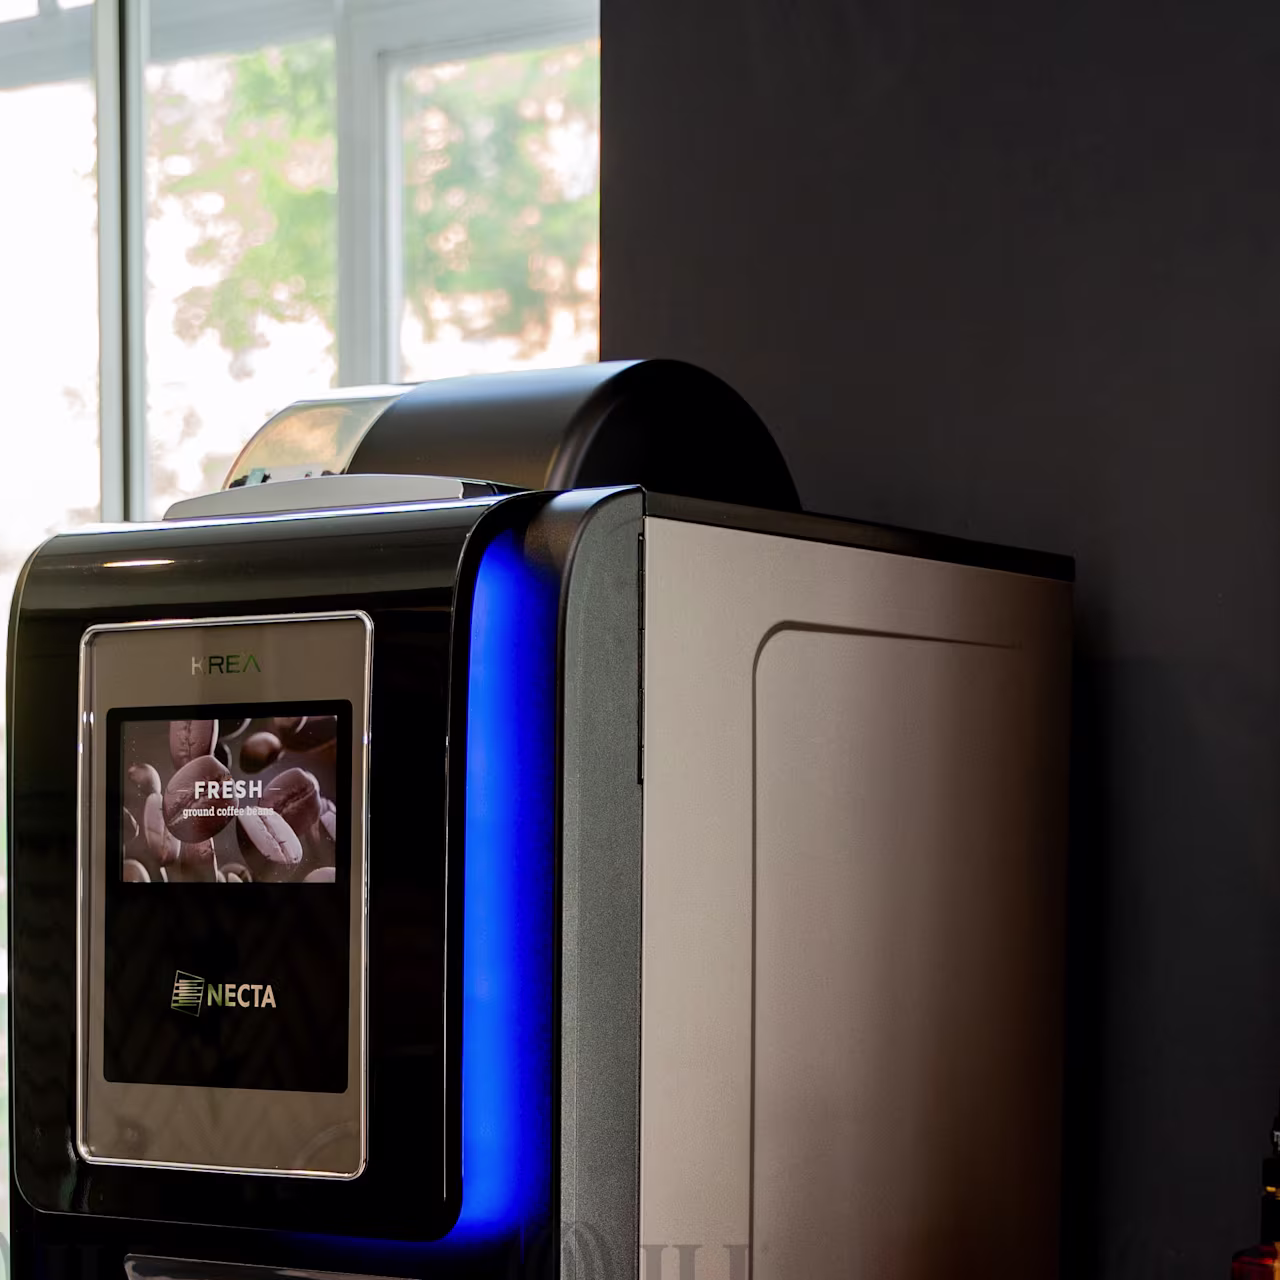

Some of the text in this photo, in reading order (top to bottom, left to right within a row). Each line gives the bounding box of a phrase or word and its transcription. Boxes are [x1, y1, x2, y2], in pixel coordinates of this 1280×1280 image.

[194, 780, 263, 800] FRESH
[183, 806, 274, 819] ground coffee beans
[207, 983, 277, 1008] NECTA
